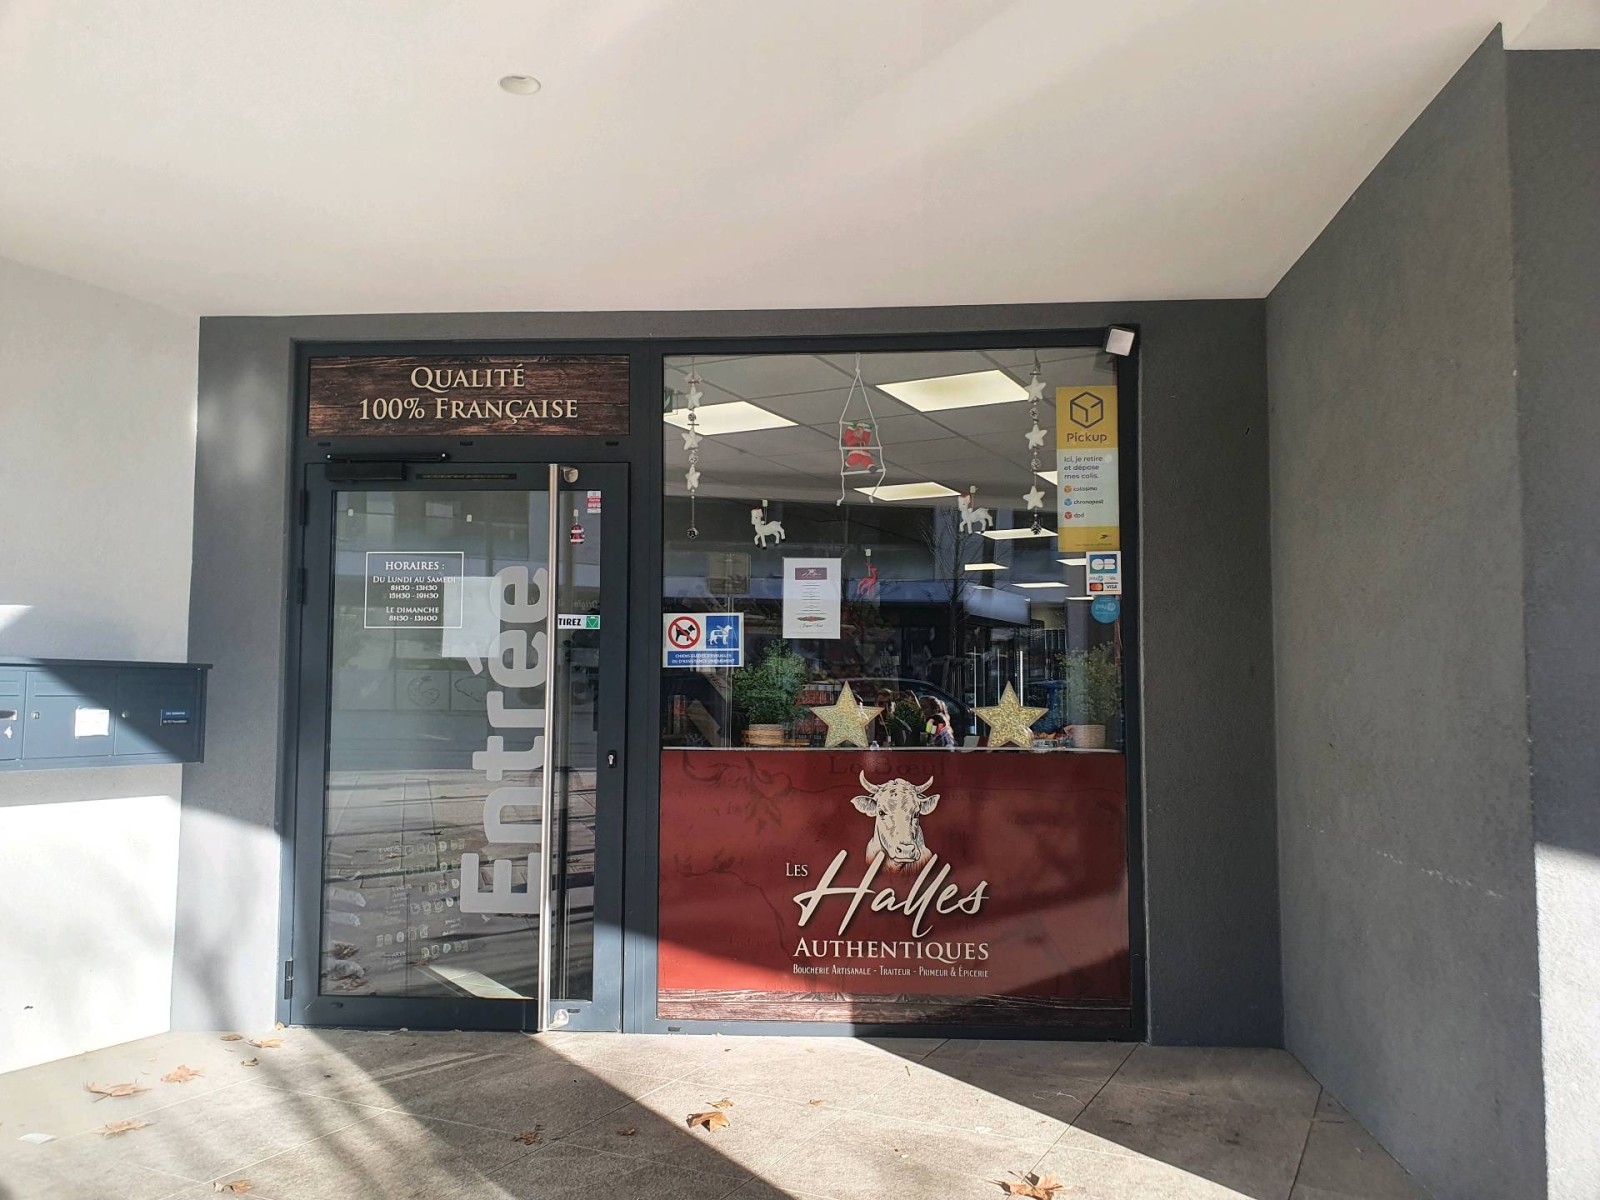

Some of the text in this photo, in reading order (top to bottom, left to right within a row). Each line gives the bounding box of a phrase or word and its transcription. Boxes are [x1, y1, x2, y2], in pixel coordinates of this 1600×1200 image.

[411, 363, 525, 393] QUALITÉ
[359, 397, 578, 424] 100% FRANÇAISE
[1066, 432, 1108, 443] Pickup
[1075, 456, 1082, 464] je
[1073, 464, 1100, 472] dépose
[385, 561, 440, 571] HORAIRES
[396, 606, 440, 614] DIMANCHE
[558, 617, 582, 627] TIREZ
[459, 566, 549, 913] Entrée
[785, 862, 808, 877] LES
[793, 849, 990, 937] Halles
[793, 937, 990, 963] AUTHENTIQUES
[950, 968, 957, 977] &
